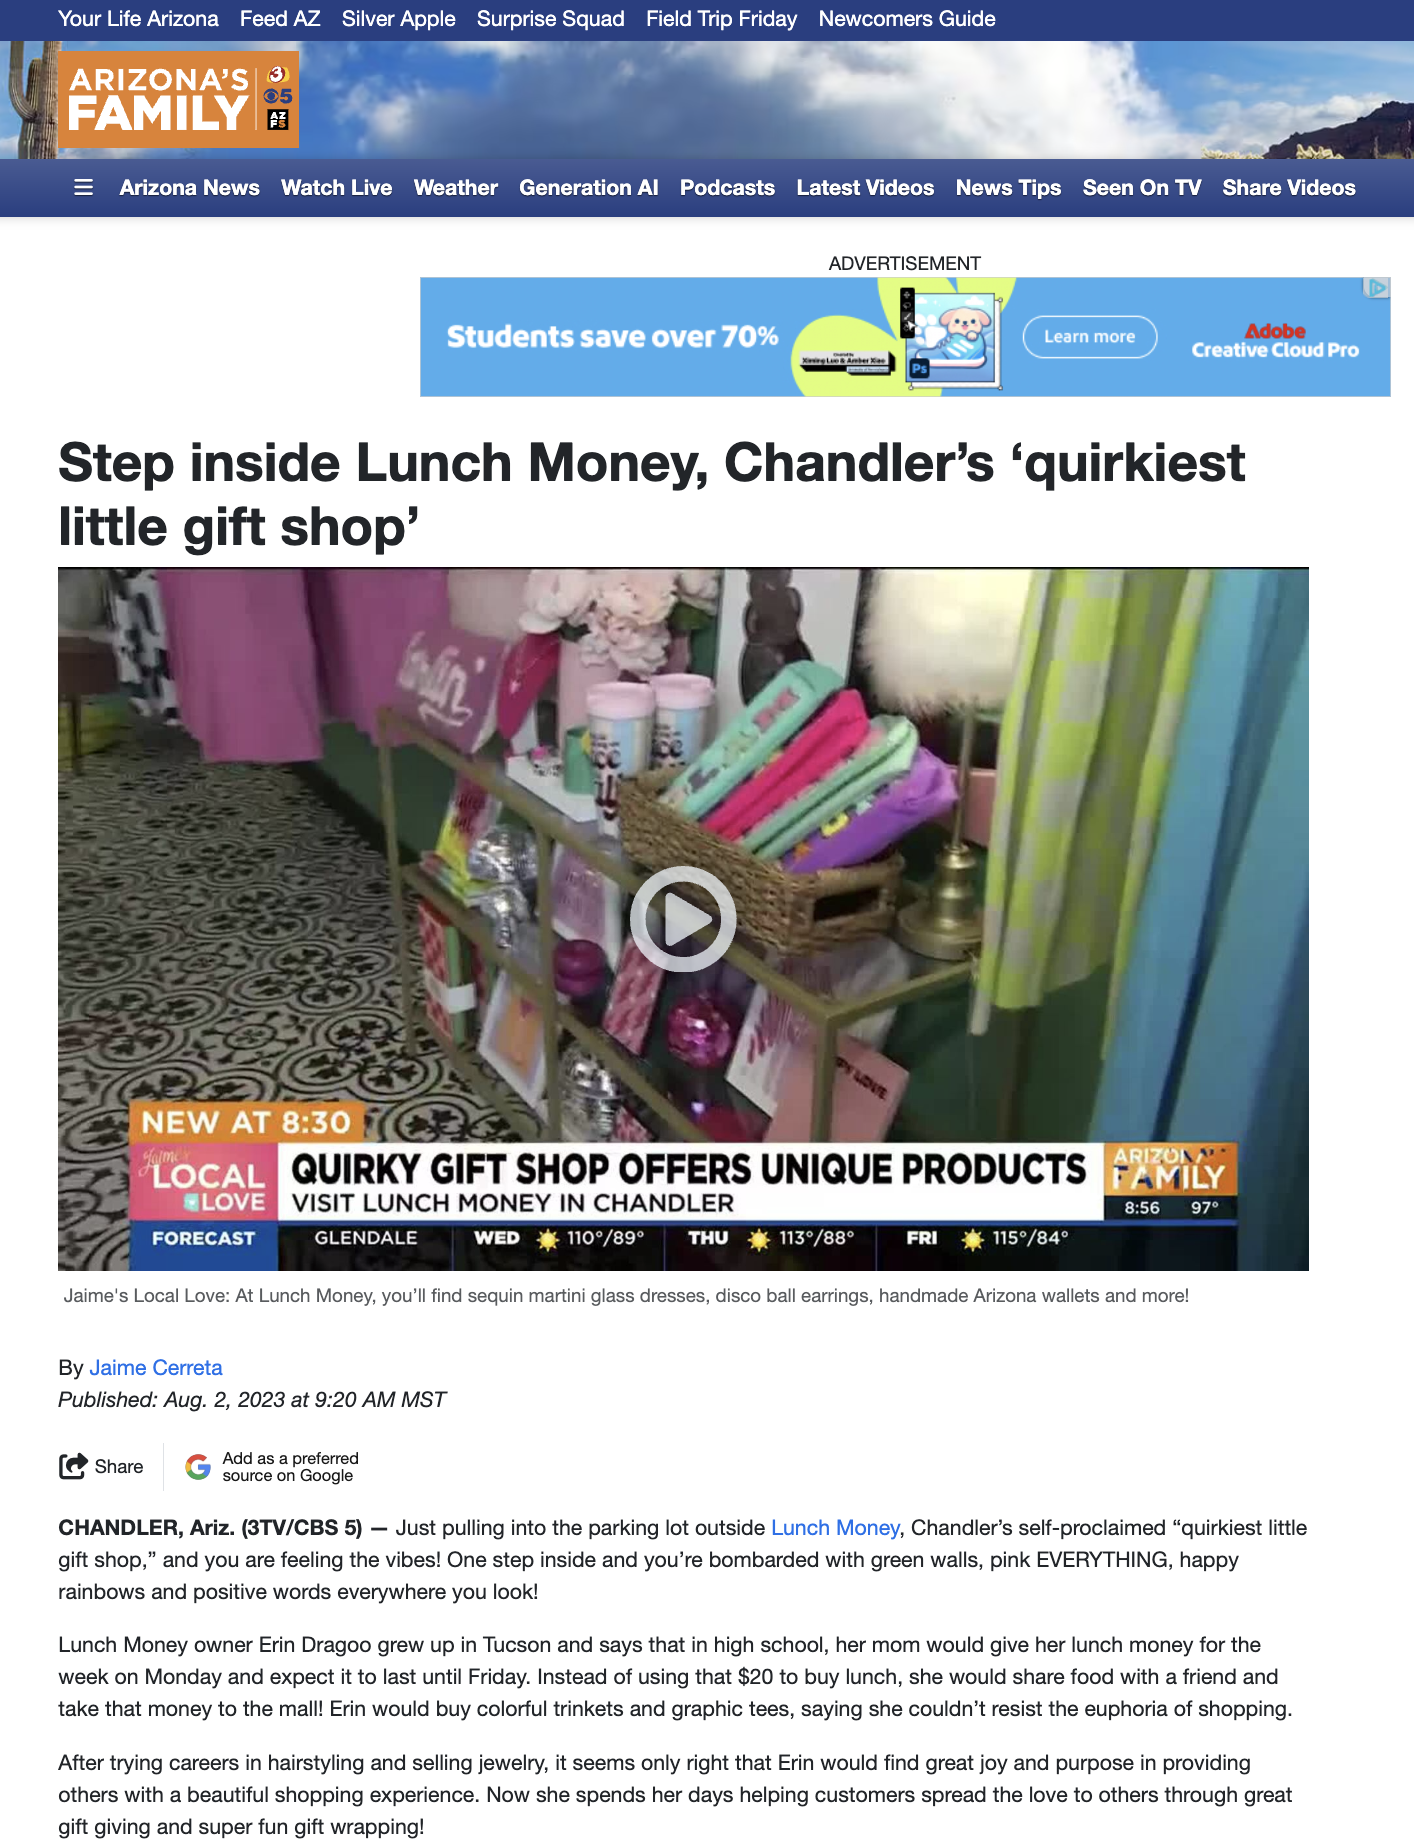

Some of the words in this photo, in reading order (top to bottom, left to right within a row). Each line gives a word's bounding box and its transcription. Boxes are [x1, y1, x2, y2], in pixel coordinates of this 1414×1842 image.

[58, 10, 102, 27] Your
[108, 10, 141, 27] Life
[147, 10, 219, 27] Arizona
[241, 10, 287, 27] Feed
[293, 10, 321, 26] AZ
[342, 10, 395, 27] Silver
[400, 10, 456, 31] Apple
[477, 10, 556, 31] Surprise
[563, 10, 624, 31] Squad
[647, 10, 691, 27] Field
[697, 10, 732, 31] Trip
[740, 10, 797, 31] Friday
[820, 10, 933, 27] Newcomers
[939, 10, 996, 27] Guide
[69, 69, 248, 91] ARIZONA’S
[69, 95, 249, 130] FAMILY
[270, 111, 287, 120] AZ
[270, 119, 287, 129] FS
[119, 179, 196, 195] Arizona
[204, 179, 260, 195] News
[281, 179, 344, 195] Watch
[352, 179, 392, 195] Live
[414, 179, 498, 195] Weather
[520, 179, 631, 195] Generation
[637, 179, 658, 195] AI
[681, 179, 775, 195] Podcasts
[798, 179, 860, 195] Latest
[866, 179, 934, 195] Videos
[957, 179, 1012, 195] News
[1018, 179, 1061, 199] Tips
[1083, 179, 1133, 195] Seen
[1140, 179, 1168, 195] On
[1175, 179, 1202, 195] TV
[1223, 179, 1281, 195] Share
[1287, 179, 1356, 195] Videos
[829, 256, 981, 270] ADVERTISEMENT
[448, 324, 574, 348] Students
[581, 330, 645, 348] save
[652, 330, 716, 348] over
[722, 325, 779, 348] 70%
[1045, 330, 1088, 343] Learn
[1095, 333, 1135, 343] more
[1245, 324, 1306, 338] Adobe
[1192, 342, 1269, 357] Creative
[1272, 342, 1323, 357] Cloud
[1328, 342, 1359, 357] Pro
[912, 363, 927, 374] Ps
[59, 441, 174, 491] Step
[192, 442, 340, 482] inside
[359, 442, 510, 482] Lunch
[531, 442, 707, 491] Money,
[726, 441, 994, 482] Chandler’s
[1013, 442, 1245, 491] ‘quirkiest
[61, 506, 167, 546] little
[184, 506, 265, 556] gift
[281, 506, 417, 555] shop’
[64, 1288, 128, 1302] Jaime's
[135, 1288, 178, 1302] Local
[186, 1288, 229, 1302] Love:
[235, 1288, 253, 1302] At
[260, 1288, 309, 1302] Lunch
[317, 1288, 375, 1306] Money,
[382, 1288, 425, 1306] you’ll
[431, 1288, 461, 1302] find
[468, 1288, 522, 1306] sequin
[529, 1288, 585, 1302] martini
[591, 1288, 634, 1306] glass
[640, 1288, 709, 1305] dresses,
[716, 1288, 761, 1302] disco
[767, 1288, 795, 1302] ball
[802, 1288, 872, 1306] earrings,
[880, 1288, 968, 1302] handmade
[973, 1288, 1036, 1302] Arizona
[1042, 1288, 1099, 1302] wallets
[1105, 1288, 1136, 1302] and
[1143, 1288, 1188, 1302] more!
[60, 1359, 84, 1380] By
[90, 1359, 146, 1376] Jaime
[153, 1359, 223, 1376] Cerreta
[58, 1391, 157, 1407] Published:
[163, 1391, 206, 1412] Aug.
[214, 1391, 230, 1410] 2,
[238, 1391, 285, 1407] 2023
[291, 1392, 310, 1407] at
[315, 1391, 357, 1407] 9:20
[361, 1391, 396, 1407] AM
[401, 1391, 448, 1408] MST
[95, 1459, 143, 1473] Share
[223, 1452, 252, 1464] Add
[258, 1455, 274, 1464] as
[279, 1455, 288, 1464] a
[293, 1452, 358, 1467] preferred
[223, 1472, 272, 1481] source
[277, 1472, 295, 1481] on
[300, 1469, 353, 1485] Google
[59, 1583, 145, 1599] rainbows
[152, 1583, 186, 1599] and
[194, 1583, 267, 1603] positive
[273, 1583, 331, 1599] words
[338, 1583, 446, 1604] everywhere
[452, 1587, 486, 1604] you
[494, 1583, 537, 1599] look!
[59, 1818, 88, 1839] gift
[95, 1818, 150, 1839] giving
[157, 1818, 192, 1834] and
[199, 1822, 253, 1838] super
[258, 1818, 287, 1834] fun
[295, 1818, 324, 1839] gift
[330, 1818, 423, 1839] wrapping!
